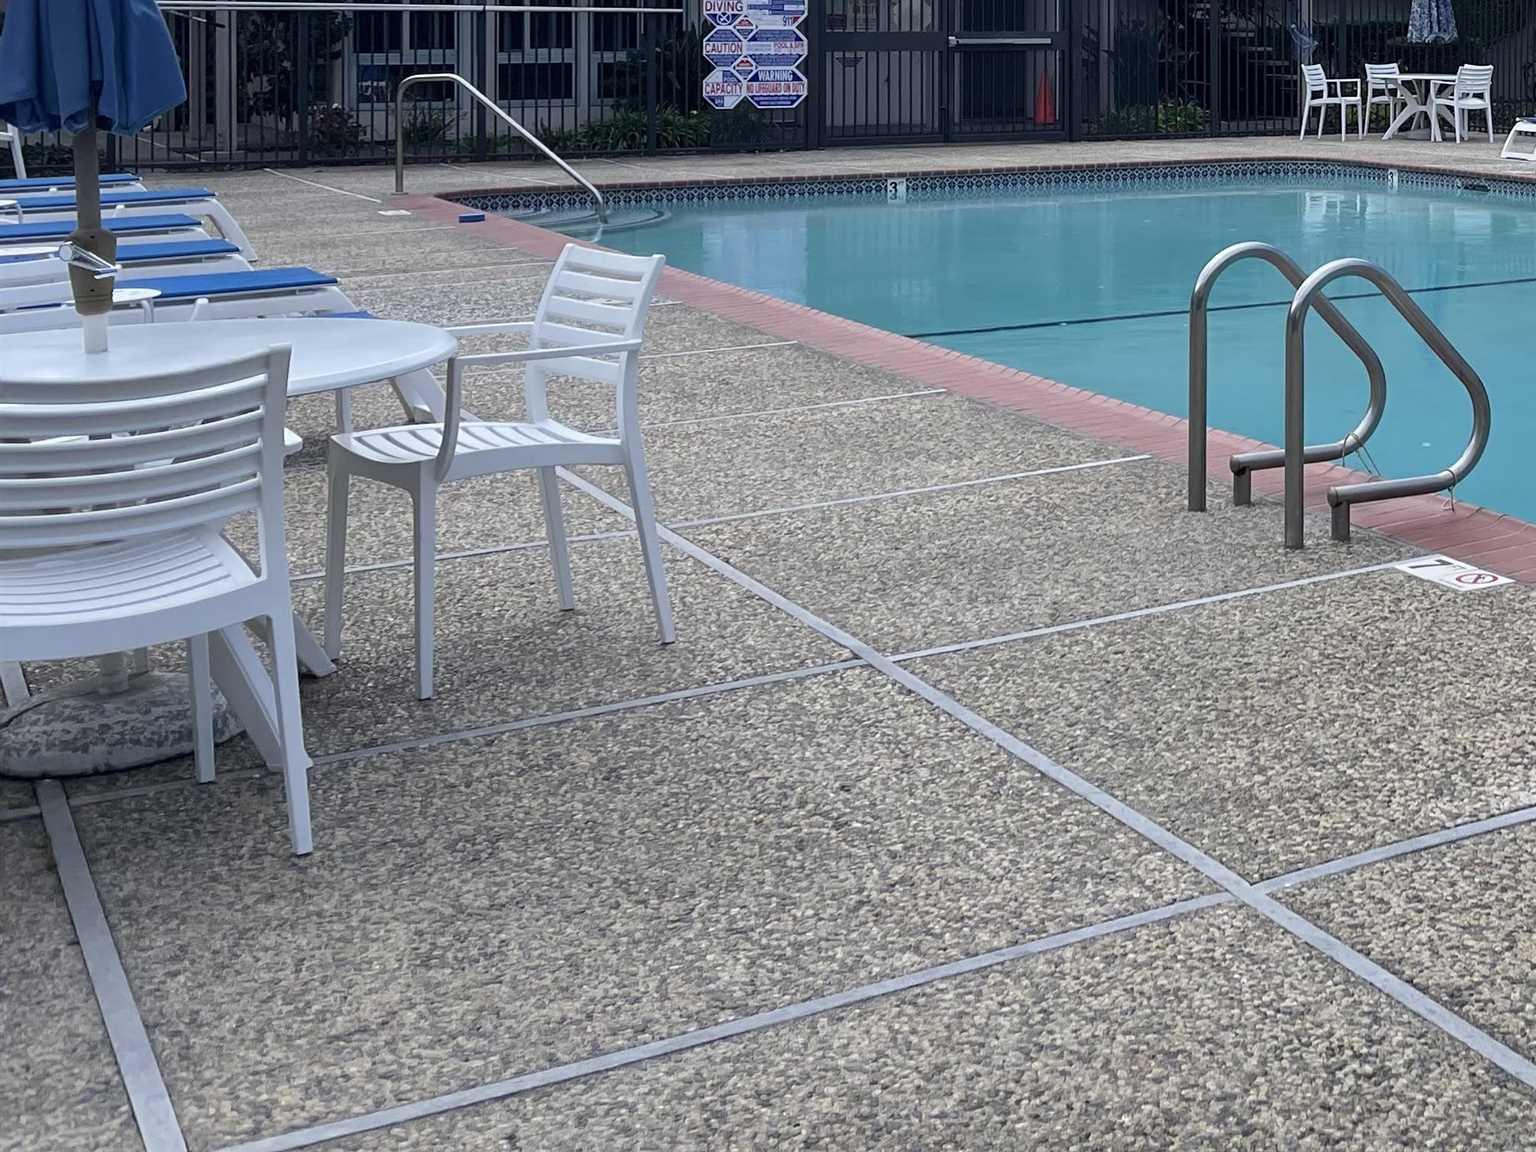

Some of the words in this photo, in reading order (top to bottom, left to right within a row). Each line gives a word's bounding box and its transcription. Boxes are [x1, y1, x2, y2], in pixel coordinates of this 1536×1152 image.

[705, 0, 743, 12] DIVING
[704, 42, 743, 53] CAUTION
[758, 70, 793, 81] WARNING
[704, 83, 743, 95] CAPACITY
[889, 181, 898, 193] 3
[1409, 558, 1454, 569] 7
